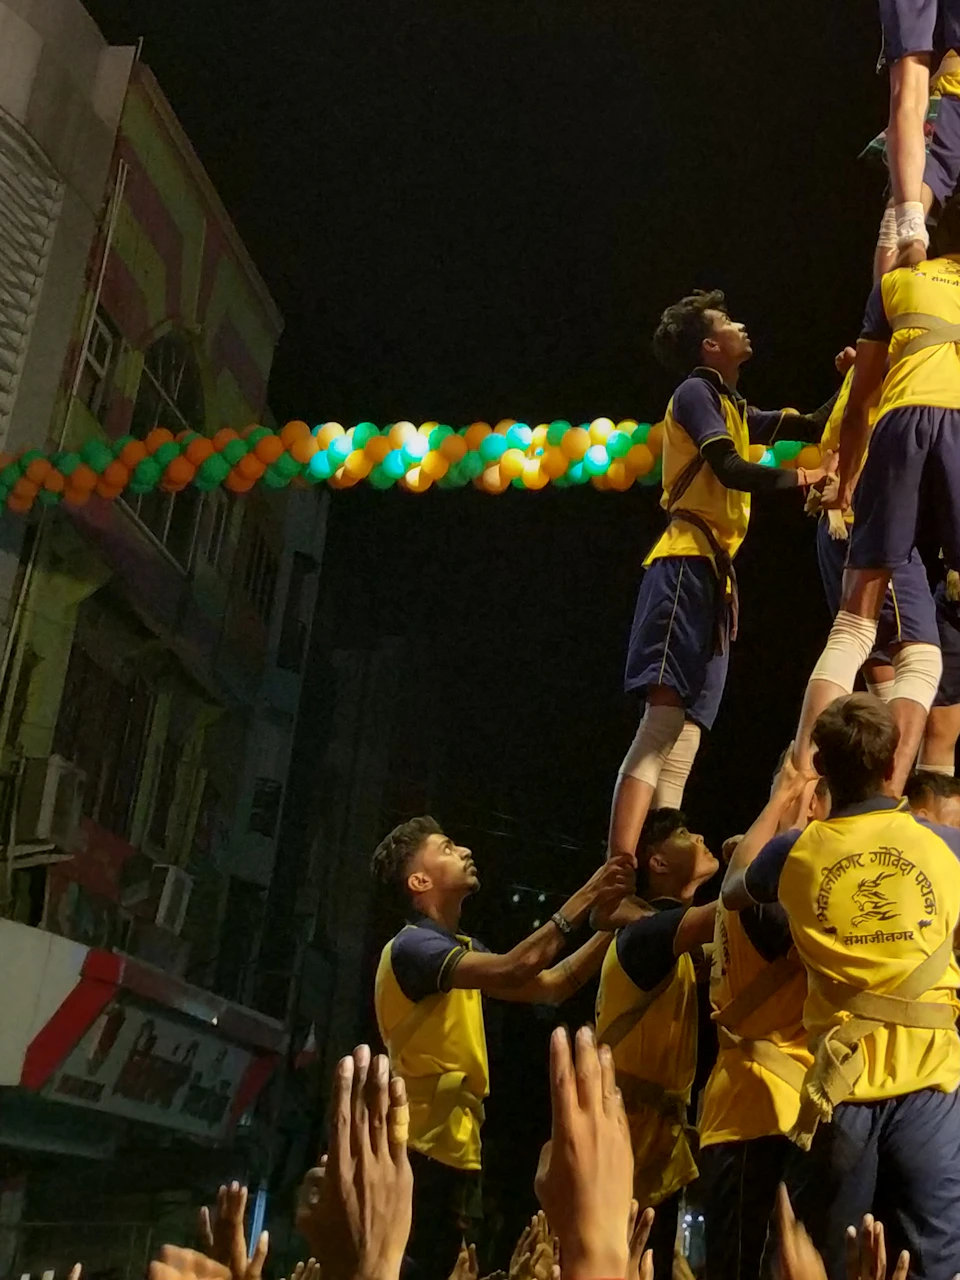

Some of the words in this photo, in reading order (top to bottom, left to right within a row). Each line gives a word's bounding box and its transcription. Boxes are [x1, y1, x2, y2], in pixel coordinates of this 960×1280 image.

[816, 852, 865, 923] भवानीनगर
[868, 846, 916, 876] गोविंदा
[914, 870, 938, 920] पथक
[843, 930, 914, 946] संभाजीनगर
